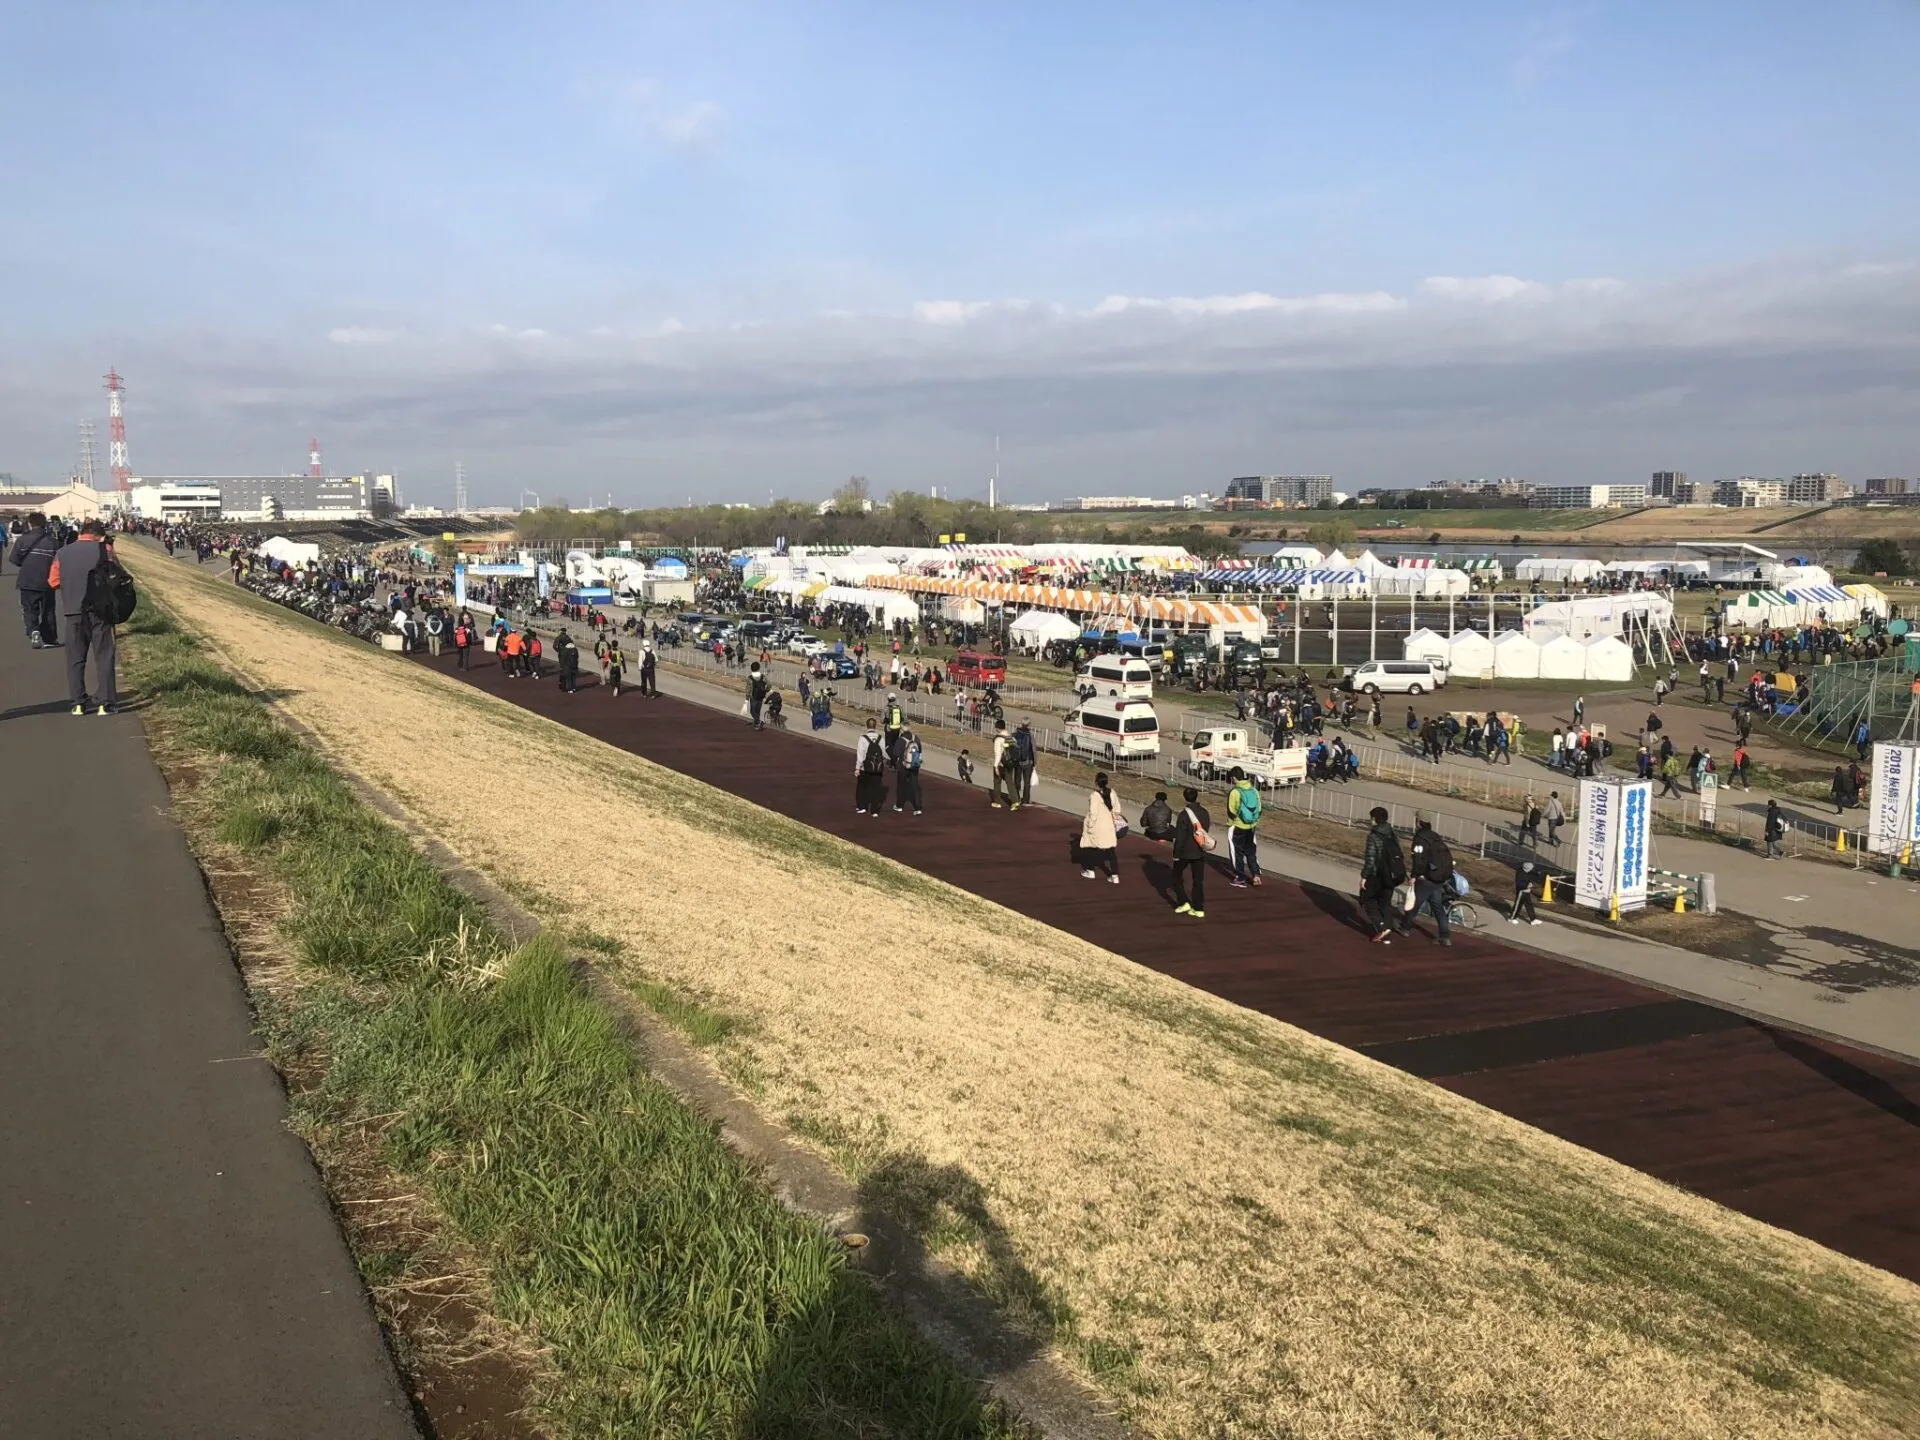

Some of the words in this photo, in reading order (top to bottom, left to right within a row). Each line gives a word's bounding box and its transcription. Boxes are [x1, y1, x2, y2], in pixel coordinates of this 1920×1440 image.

[1889, 748, 1902, 775] 2018
[1703, 775, 1715, 788] A
[1596, 786, 1608, 816] 2018
